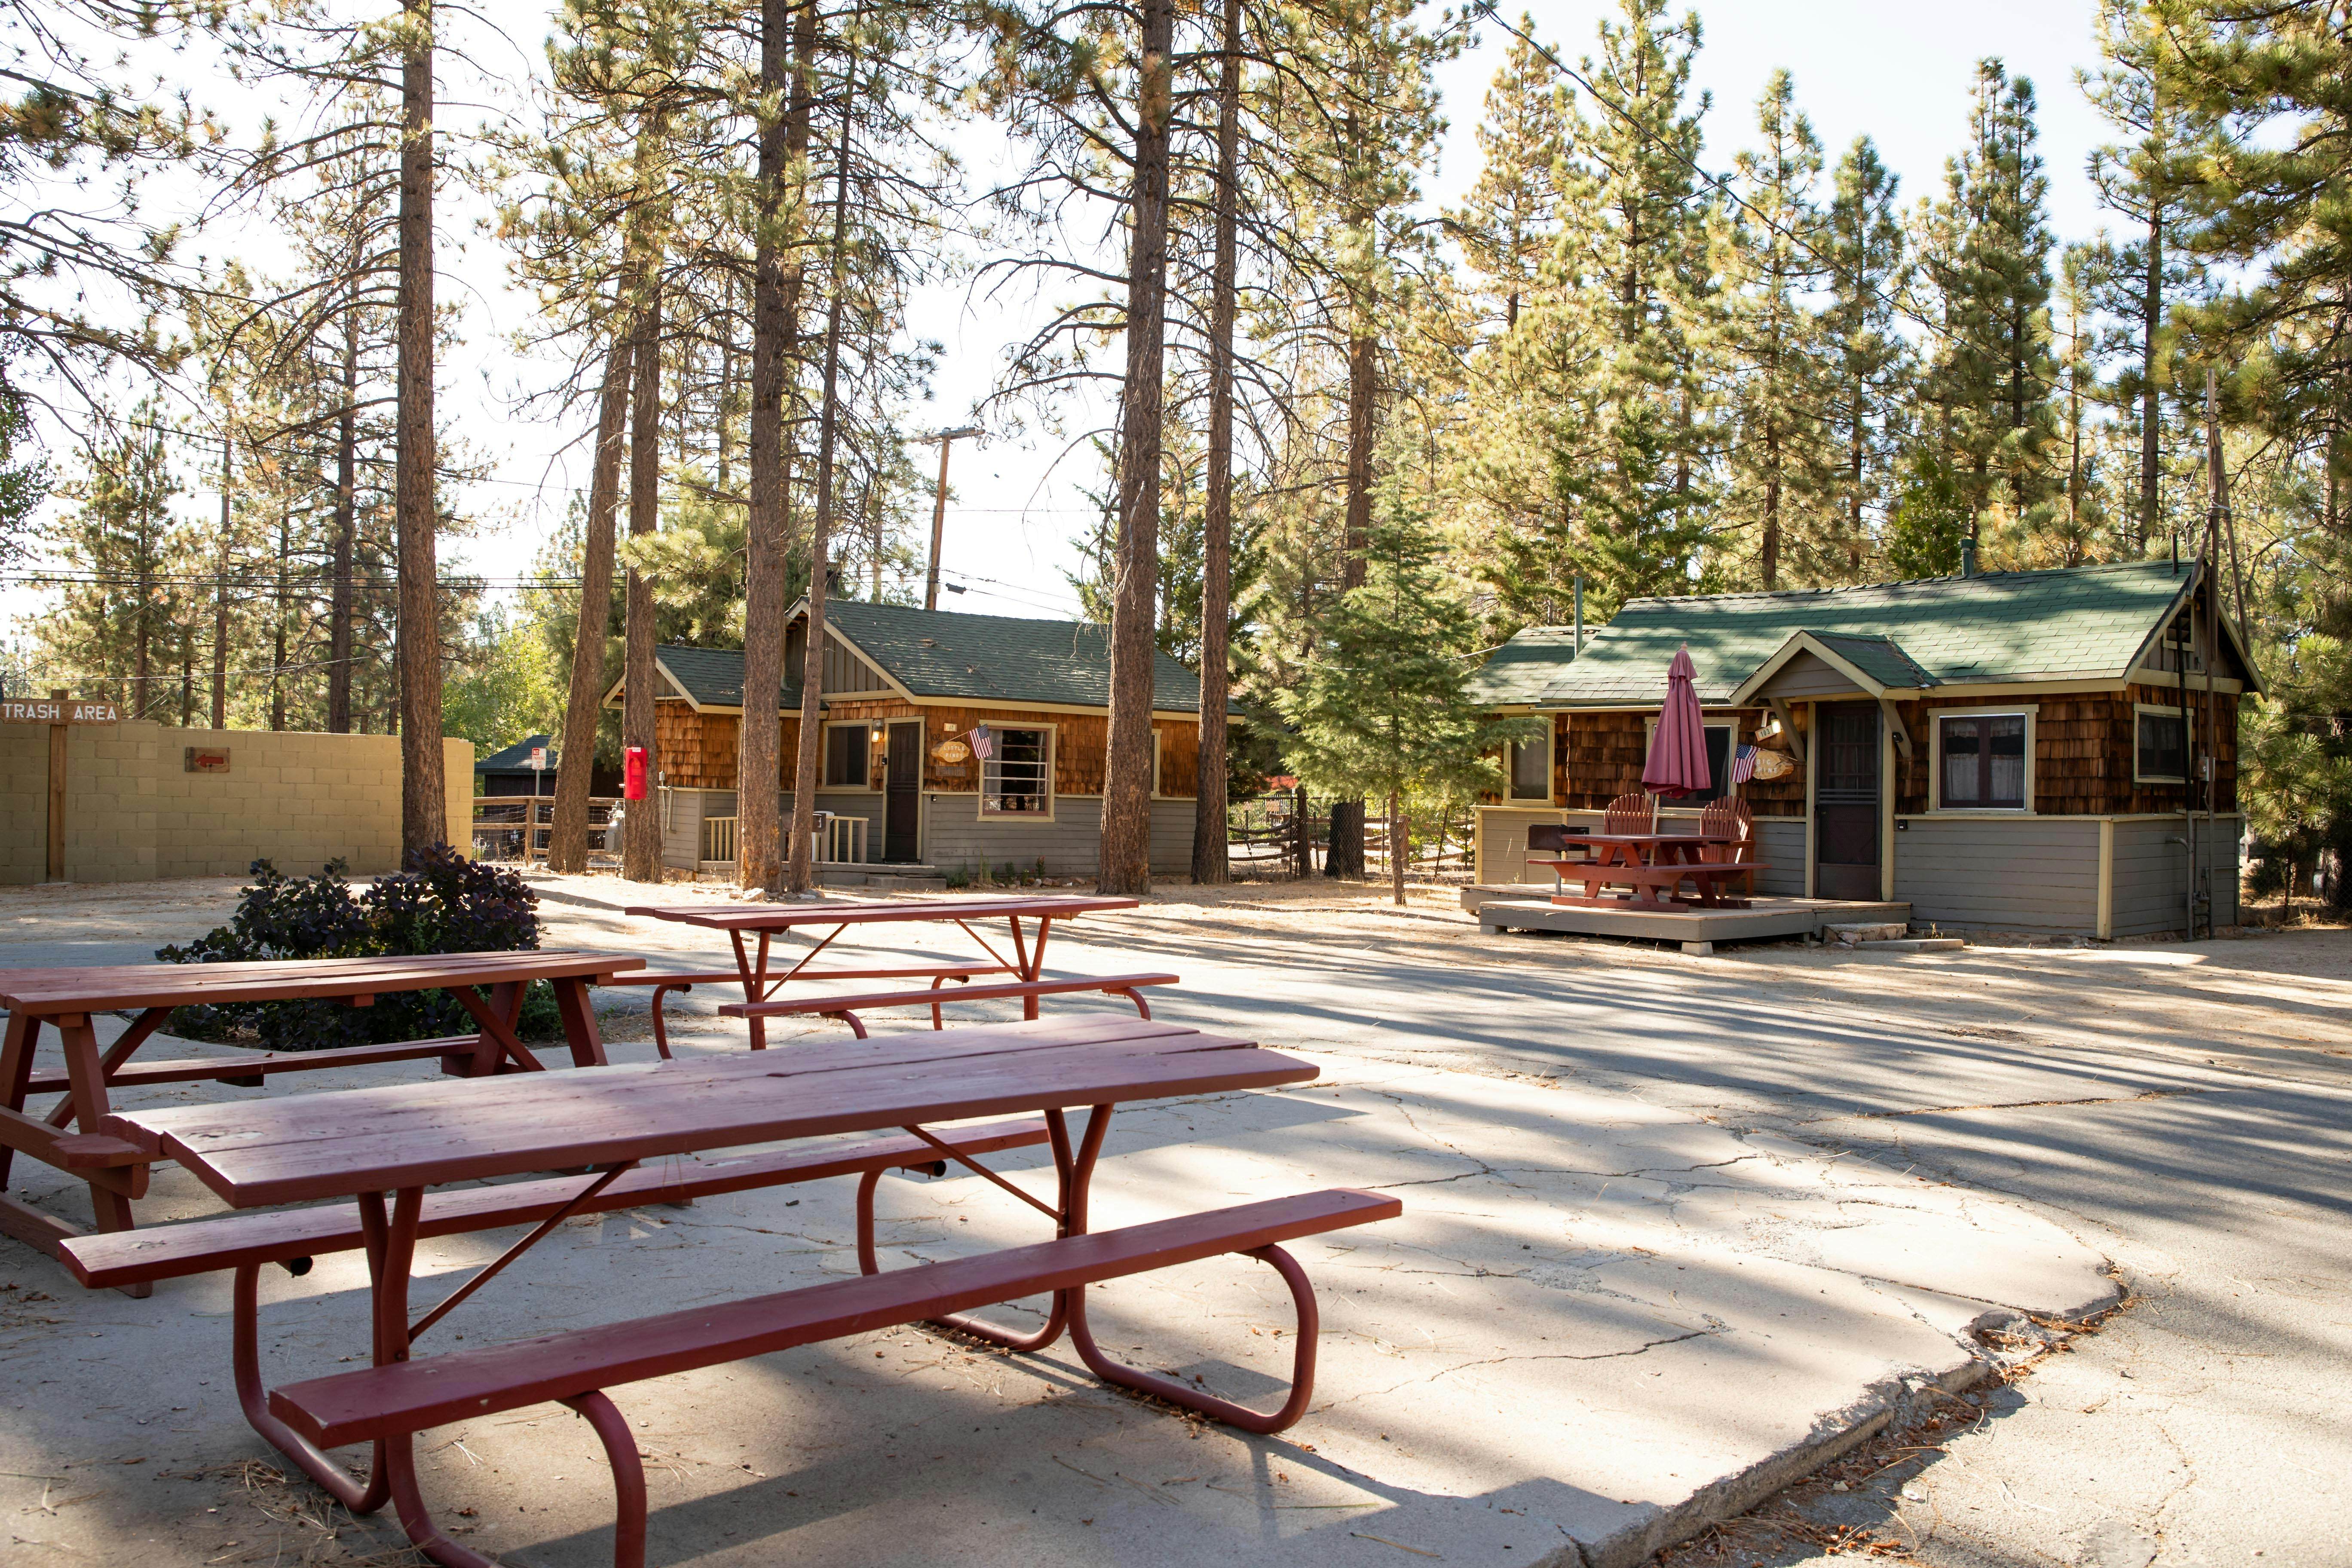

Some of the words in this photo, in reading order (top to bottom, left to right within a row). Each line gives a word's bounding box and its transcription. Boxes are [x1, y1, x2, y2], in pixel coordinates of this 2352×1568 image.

[3, 704, 59, 719] TRASH
[74, 705, 116, 720] AREA
[1761, 729, 1770, 737] 103
